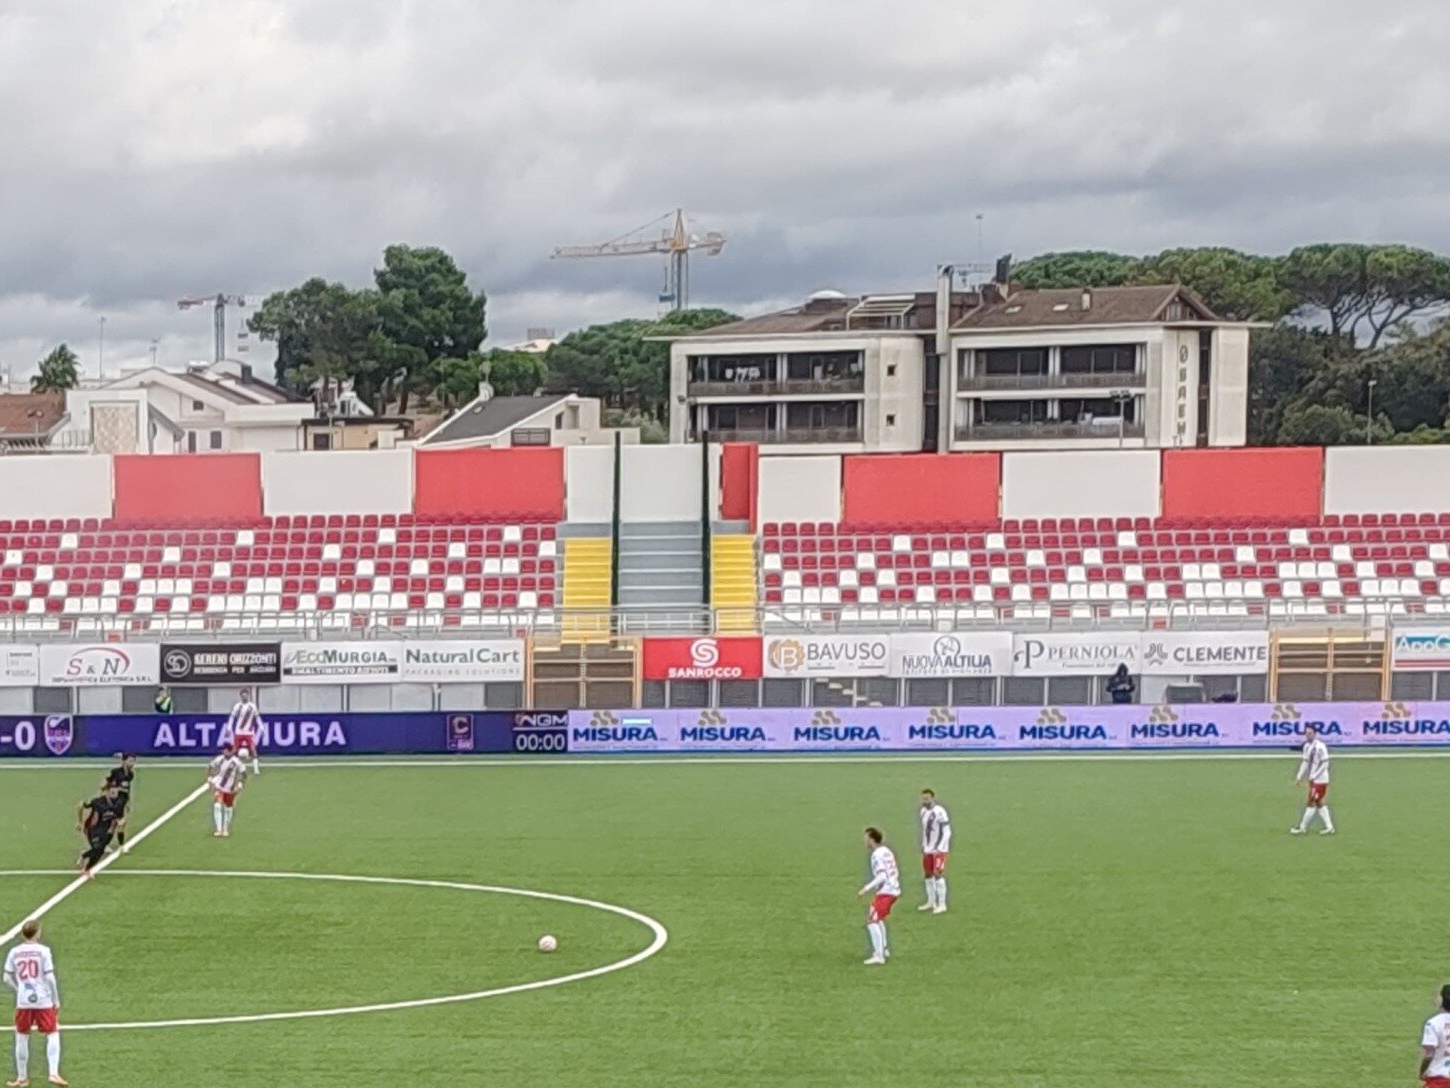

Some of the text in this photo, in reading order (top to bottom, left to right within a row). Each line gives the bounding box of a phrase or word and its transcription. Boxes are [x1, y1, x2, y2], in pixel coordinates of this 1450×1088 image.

[807, 642, 886, 660] BAVUSO
[1173, 646, 1267, 662] CLEMENTE
[102, 658, 121, 675] N
[573, 727, 658, 741] MISURA
[680, 727, 766, 741] MISURA
[794, 726, 881, 741] MISURA
[908, 725, 996, 739] MISURA
[1019, 725, 1107, 740] MISURA
[1131, 722, 1219, 738] MISURA
[516, 734, 565, 750] 00:00
[17, 959, 39, 980] 20
